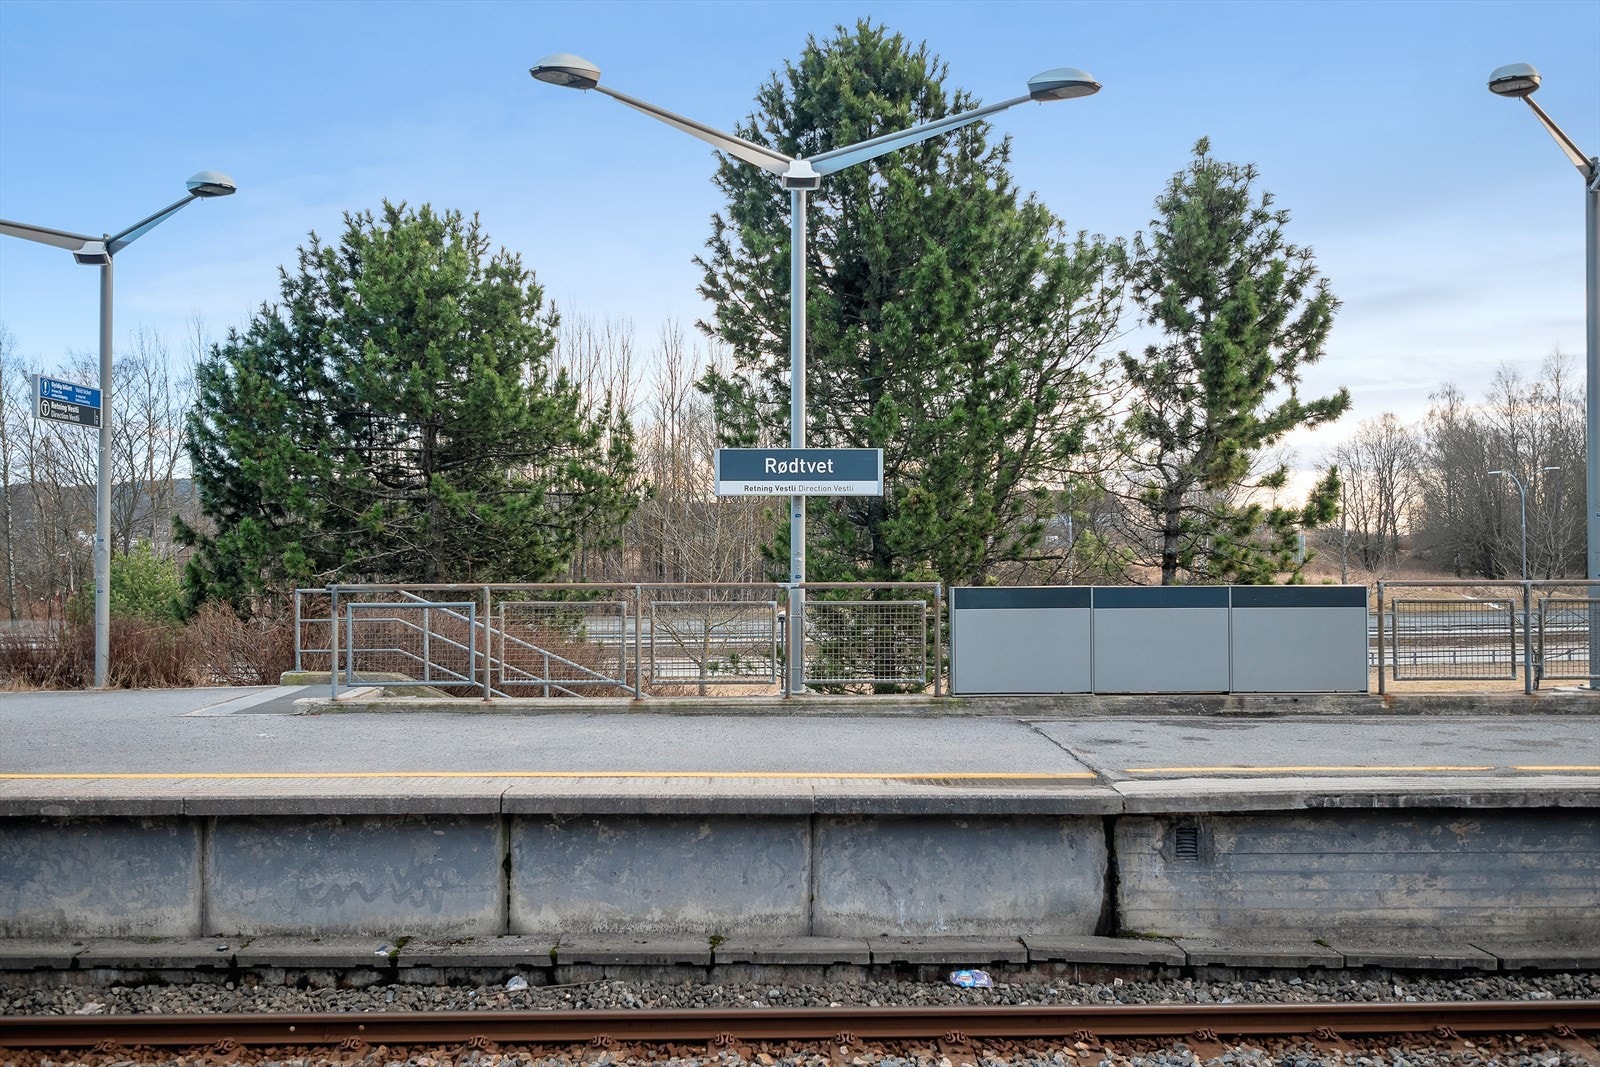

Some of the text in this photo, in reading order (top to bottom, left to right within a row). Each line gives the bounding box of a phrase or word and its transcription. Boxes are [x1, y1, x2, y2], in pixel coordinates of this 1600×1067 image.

[51, 401, 67, 412] Retning
[765, 457, 834, 474] Rødtvet
[744, 485, 773, 493] Retning
